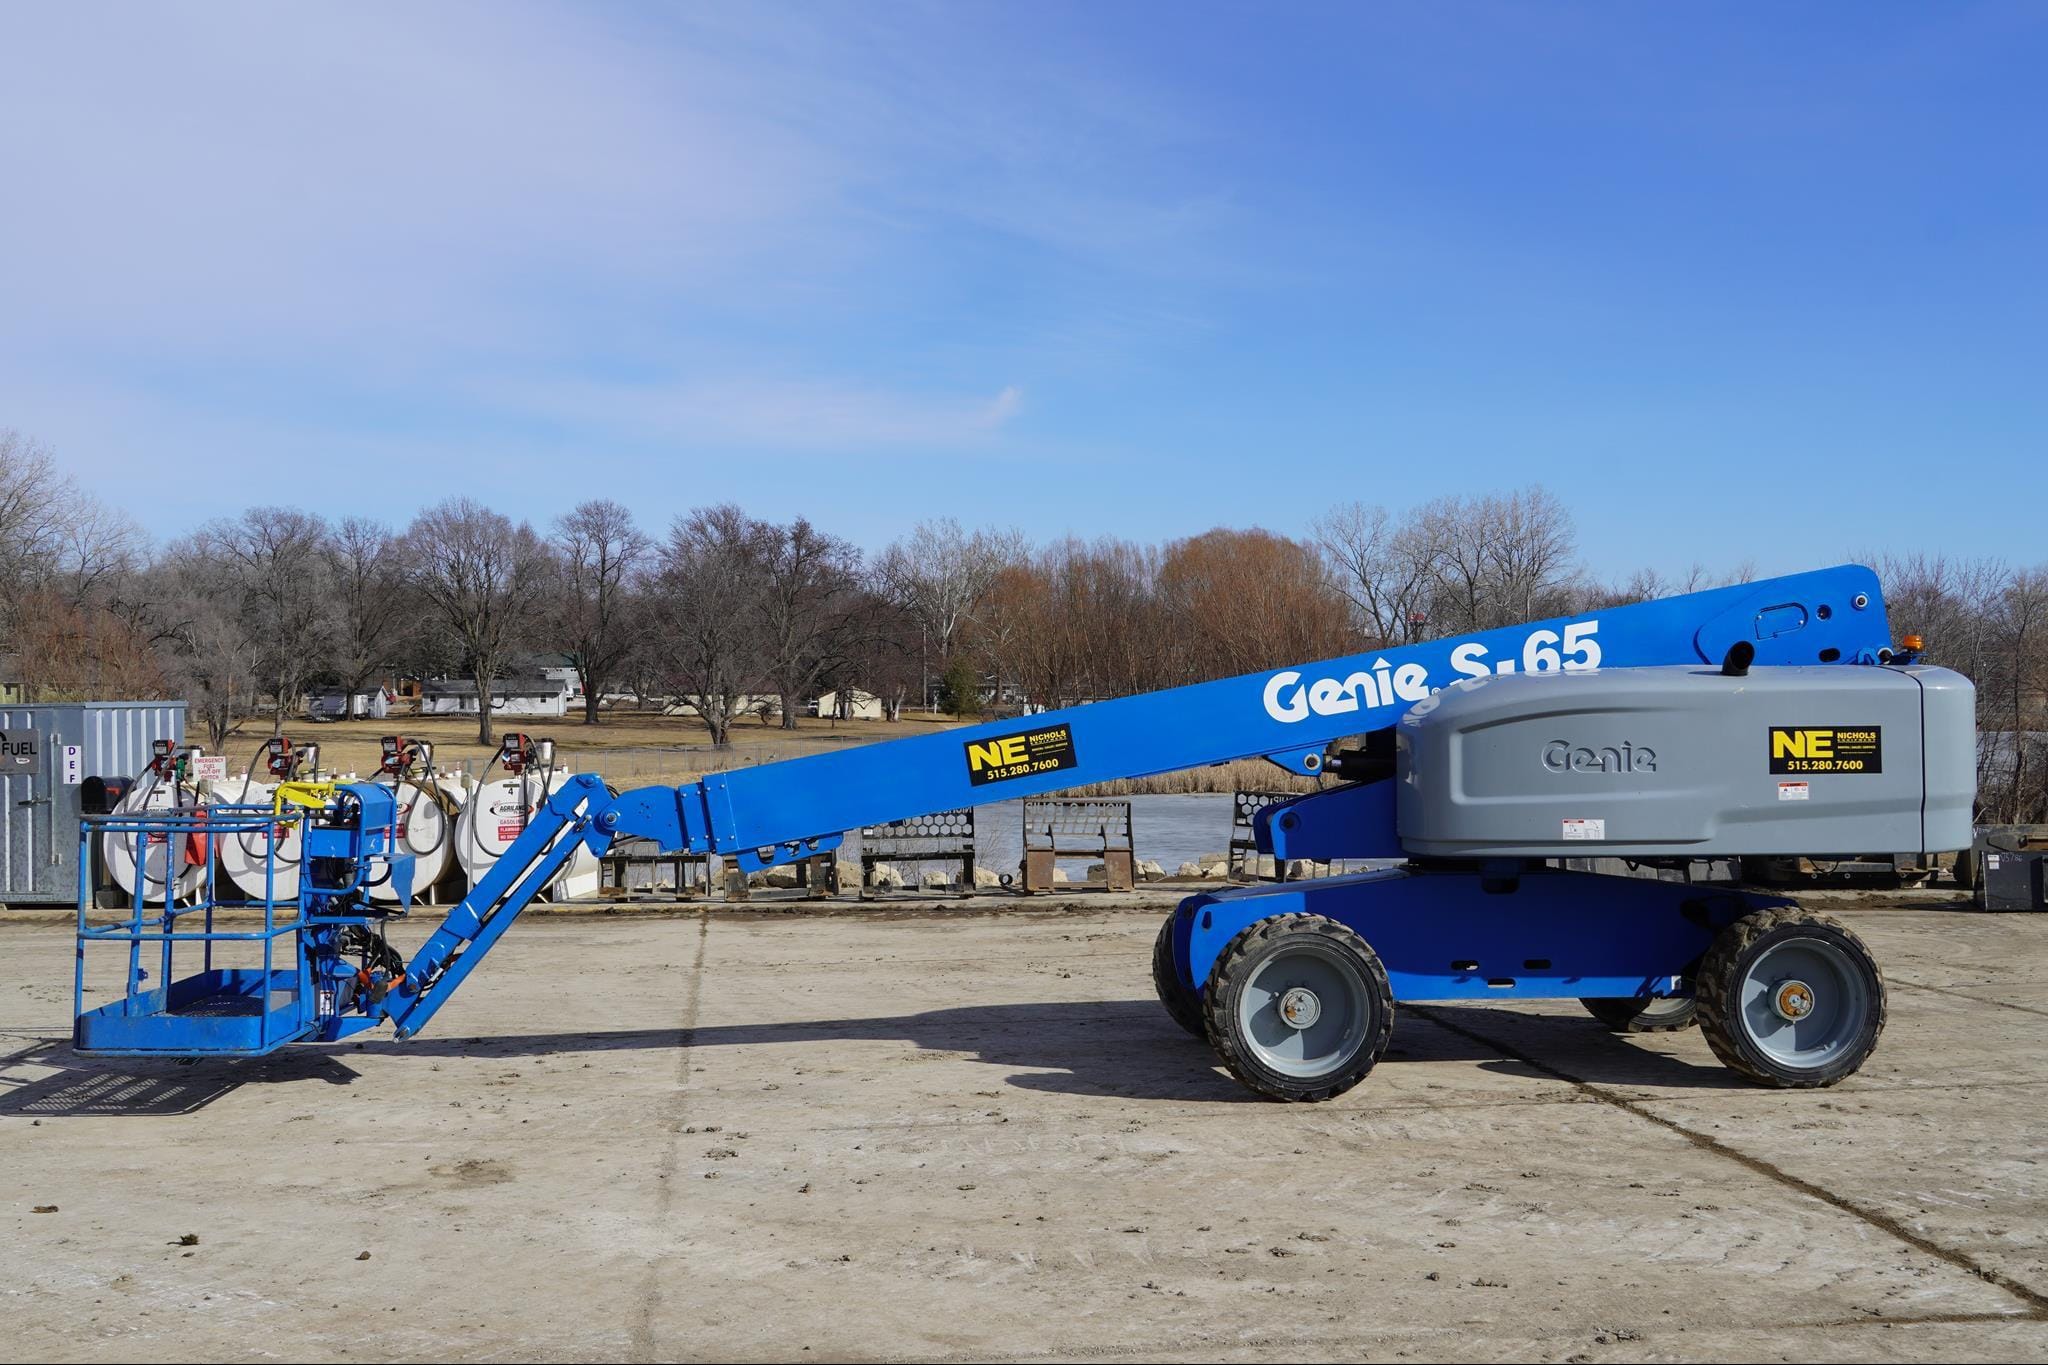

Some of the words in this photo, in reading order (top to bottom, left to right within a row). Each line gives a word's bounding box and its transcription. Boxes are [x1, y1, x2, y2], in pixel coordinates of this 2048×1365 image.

[1450, 620, 1602, 687] S-65
[1263, 656, 1430, 724] Genie
[2, 742, 37, 756] FUEL
[1029, 729, 1067, 743] NICHOLS
[1772, 730, 1834, 759] NE
[968, 735, 1030, 772] NE
[1541, 738, 1657, 774] Genie
[1787, 760, 1864, 771] 515.280.7600
[987, 758, 1059, 780] 515.280.7600
